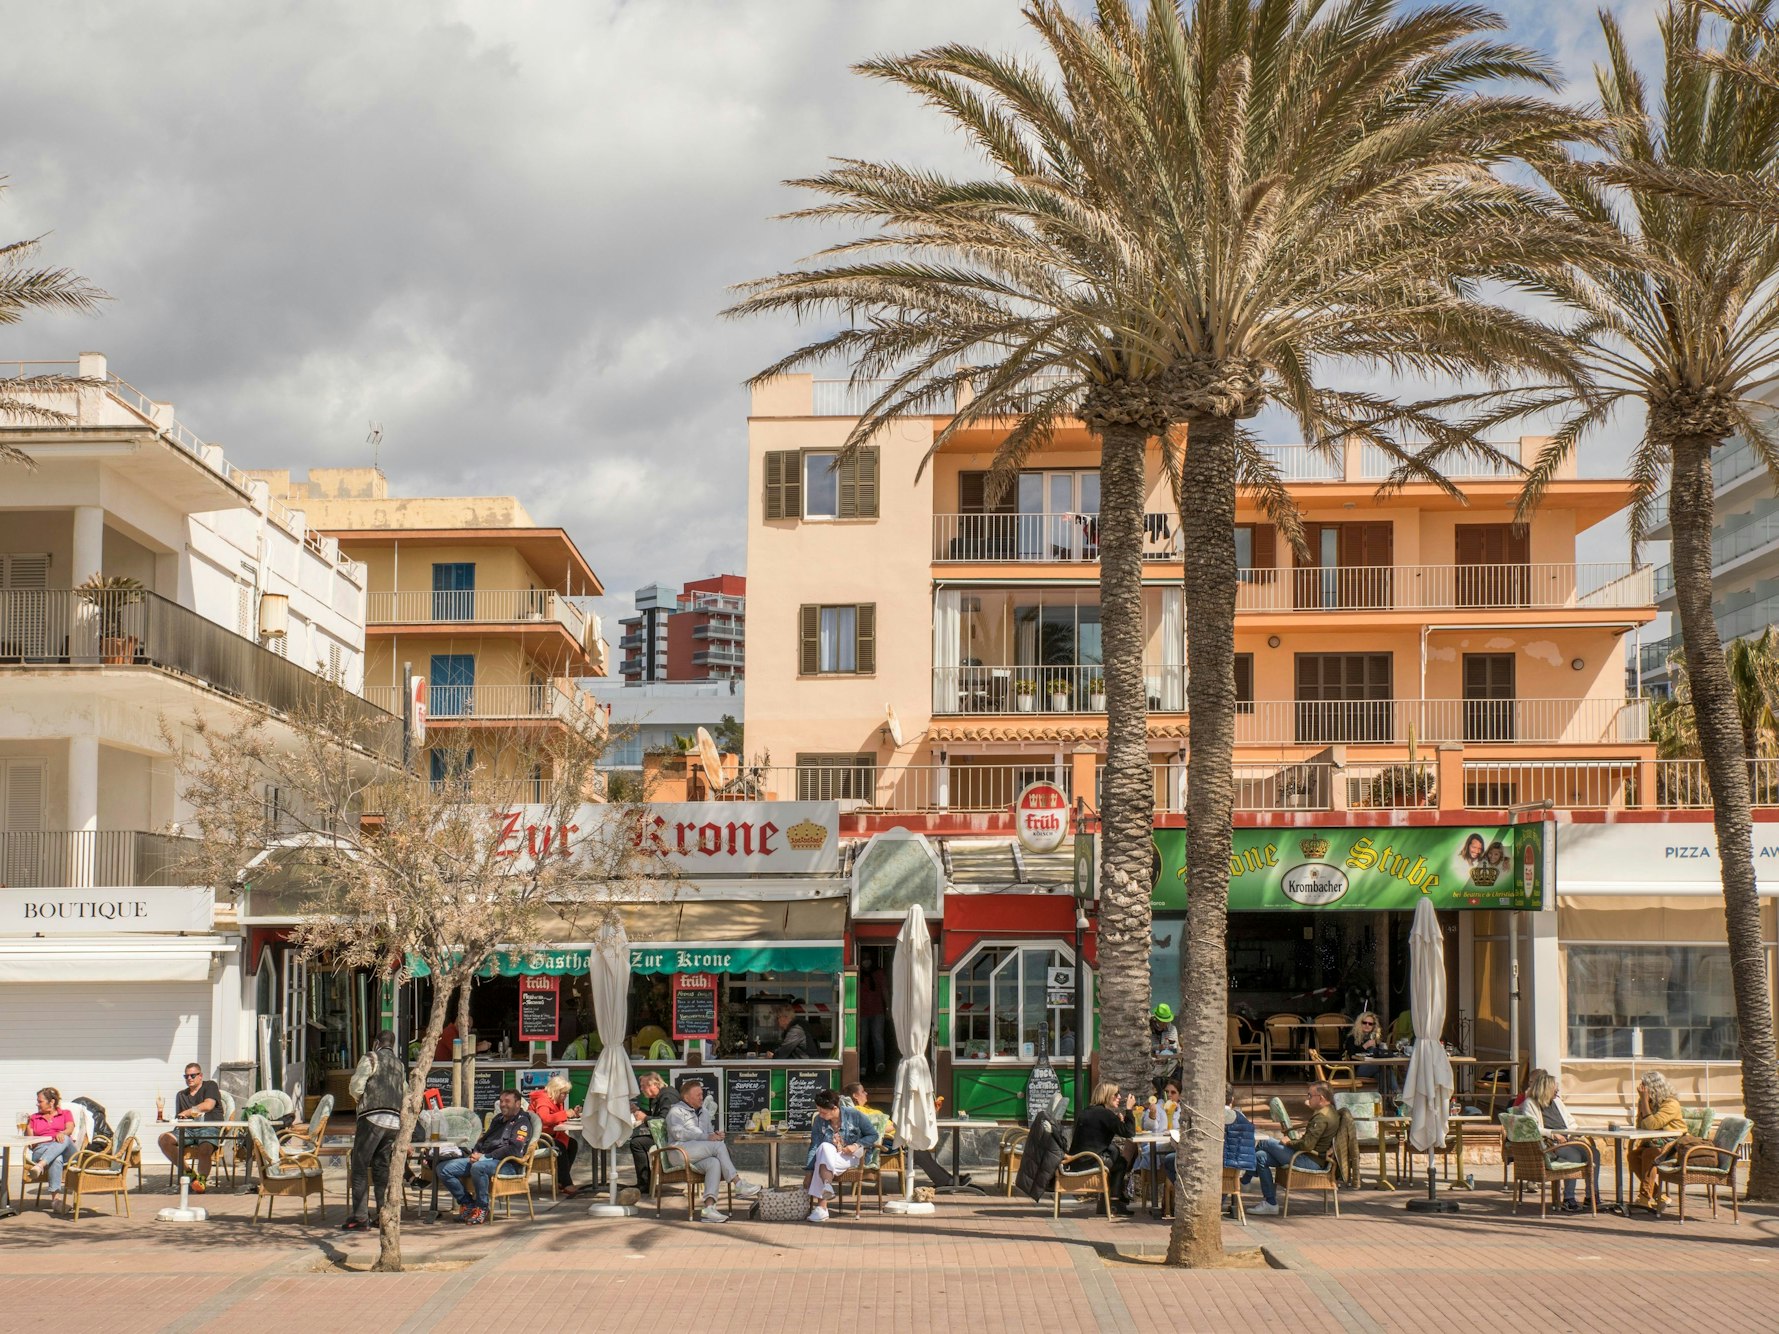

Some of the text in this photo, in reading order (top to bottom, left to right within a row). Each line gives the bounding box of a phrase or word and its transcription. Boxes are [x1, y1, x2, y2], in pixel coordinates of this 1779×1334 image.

[1025, 813, 1060, 831] früh
[492, 811, 580, 859] Zur
[1665, 846, 1711, 859] PIZZA
[1345, 836, 1440, 895] Stube
[1288, 880, 1343, 894] Krombacher
[24, 901, 148, 920] BOUTIQUE
[630, 951, 664, 968] Zur
[677, 951, 732, 968] Krone
[526, 976, 550, 990] früh
[680, 974, 707, 988] früh
